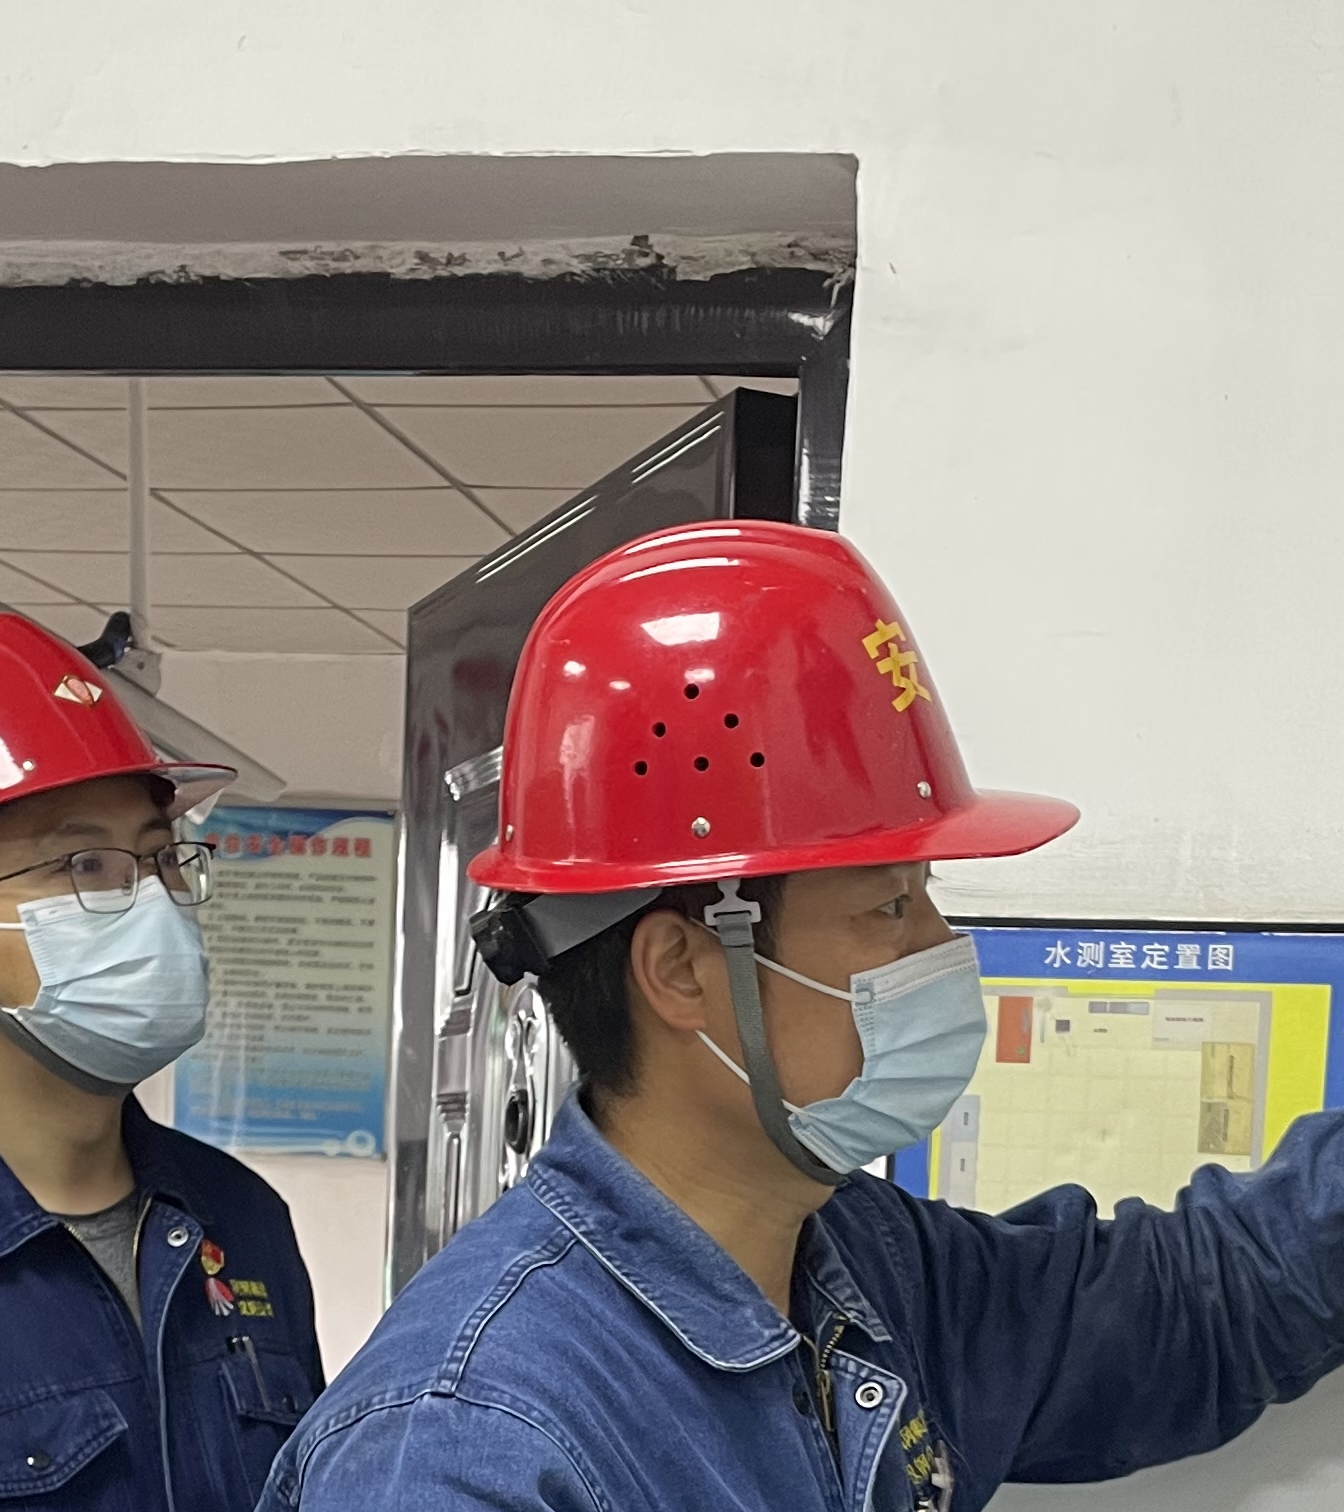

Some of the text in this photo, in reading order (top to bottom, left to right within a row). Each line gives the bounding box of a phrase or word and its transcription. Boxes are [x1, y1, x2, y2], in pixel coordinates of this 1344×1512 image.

[862, 618, 932, 712] 安
[1044, 941, 1235, 971] 水测室定置图
